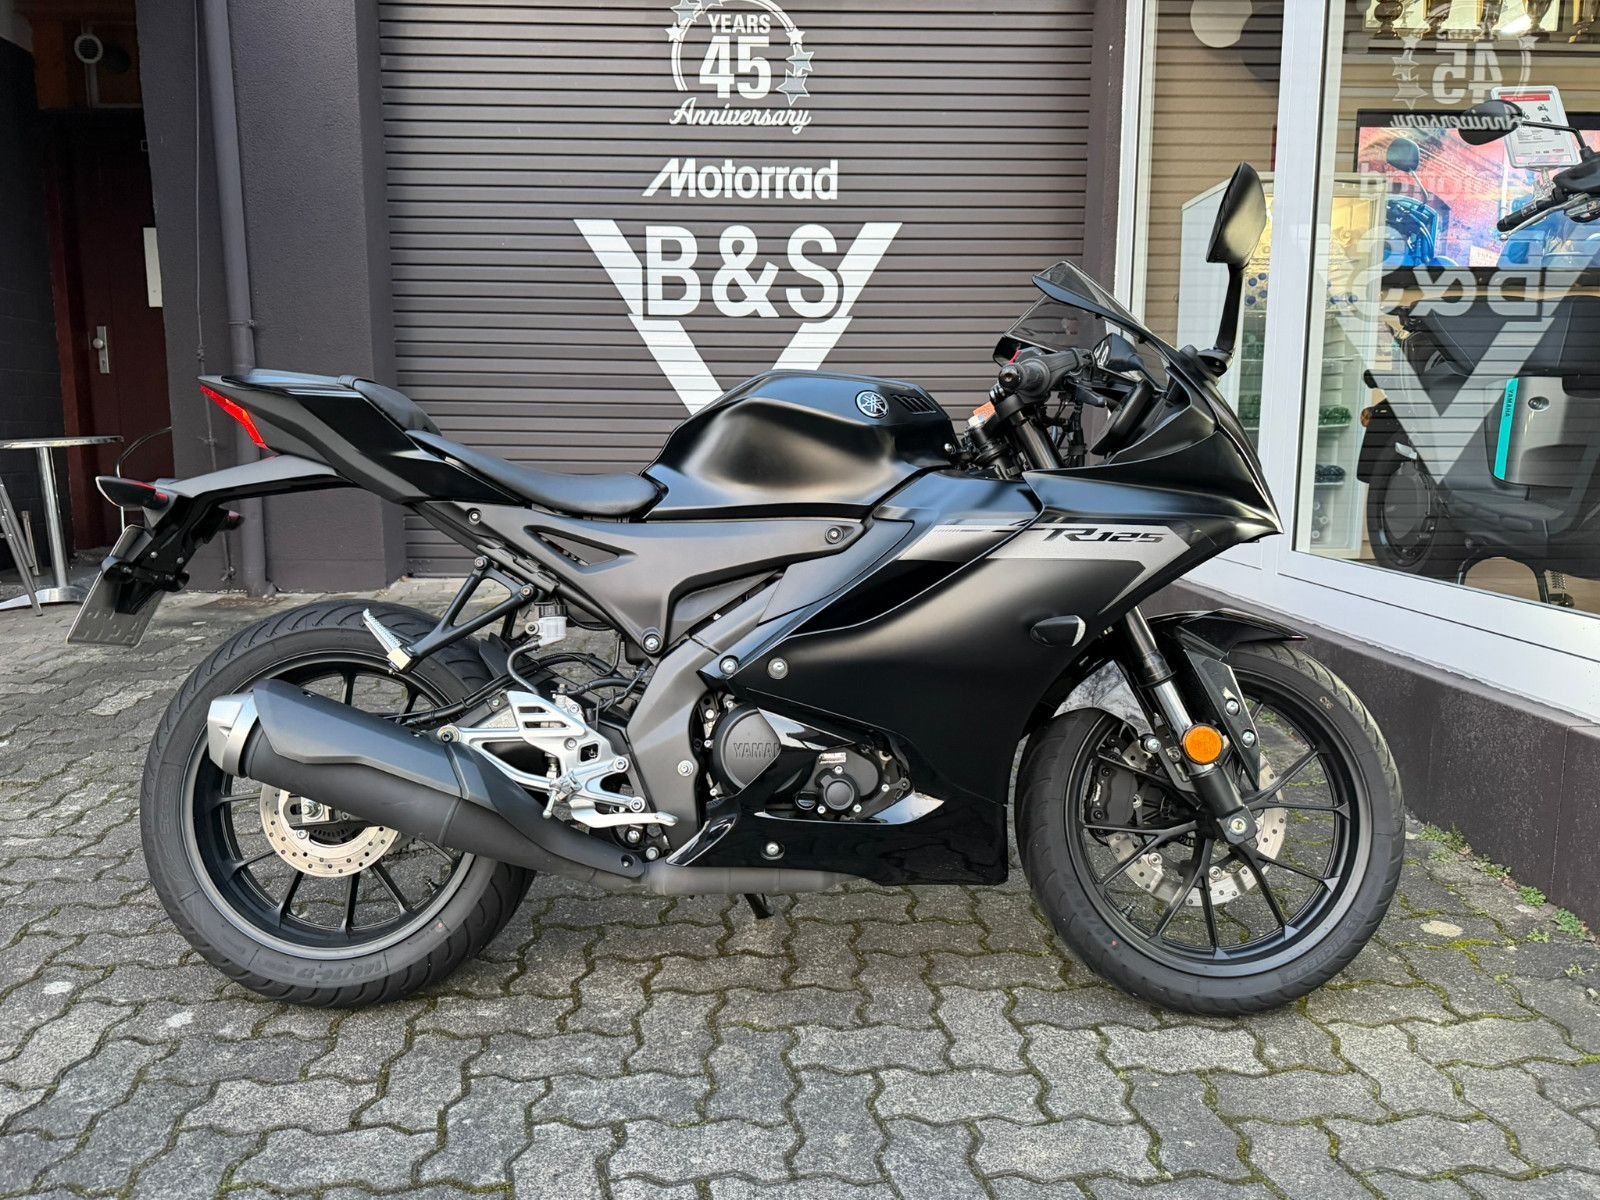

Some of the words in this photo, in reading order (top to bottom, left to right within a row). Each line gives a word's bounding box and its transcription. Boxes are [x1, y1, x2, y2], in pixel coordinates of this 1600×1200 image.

[707, 14, 771, 34] YEARS
[699, 35, 773, 99] 45
[668, 97, 812, 135] Anniversary
[641, 157, 839, 200] Motorrad
